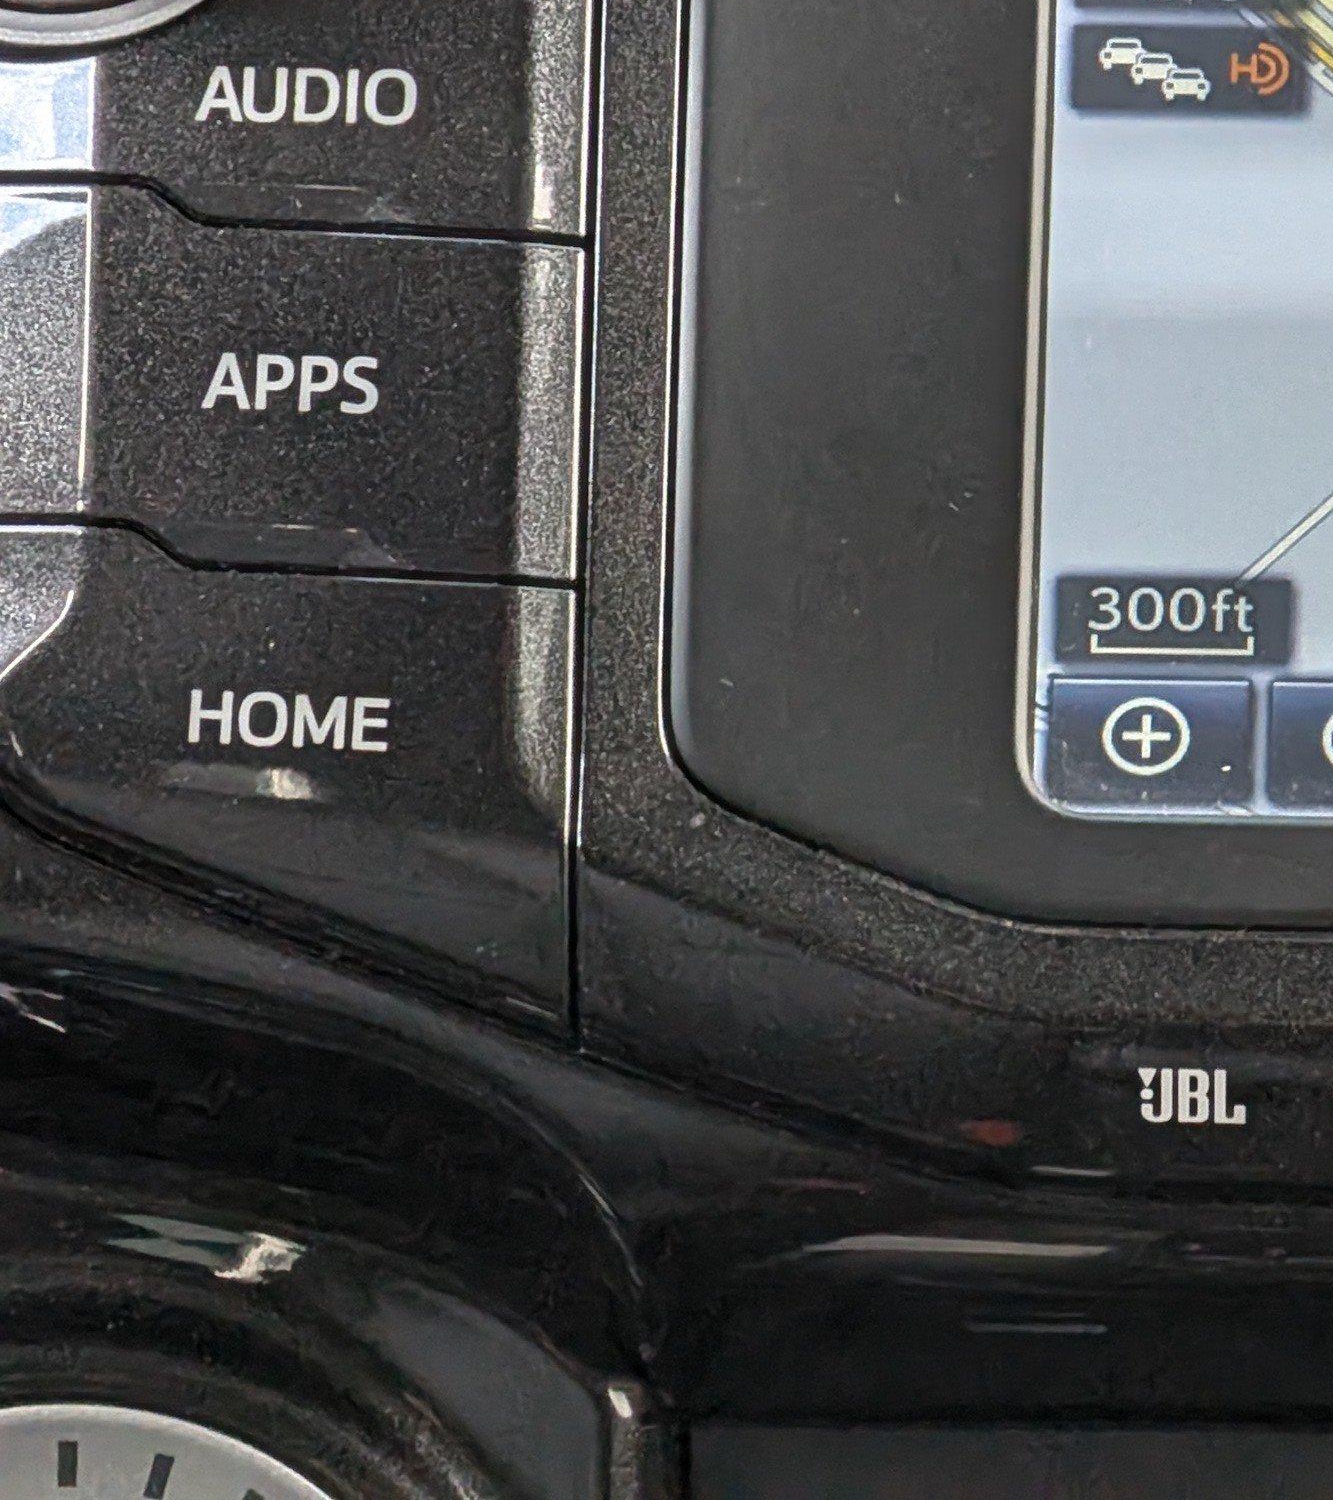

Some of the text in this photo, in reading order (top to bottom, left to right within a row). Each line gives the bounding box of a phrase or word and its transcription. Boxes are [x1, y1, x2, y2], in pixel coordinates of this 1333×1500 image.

[194, 66, 418, 126] AUDIO
[1229, 43, 1289, 95] HD
[201, 352, 381, 415] APPS
[1088, 586, 1255, 633] 300ft
[186, 689, 392, 753] HOME
[1138, 1067, 1247, 1125] JBL
